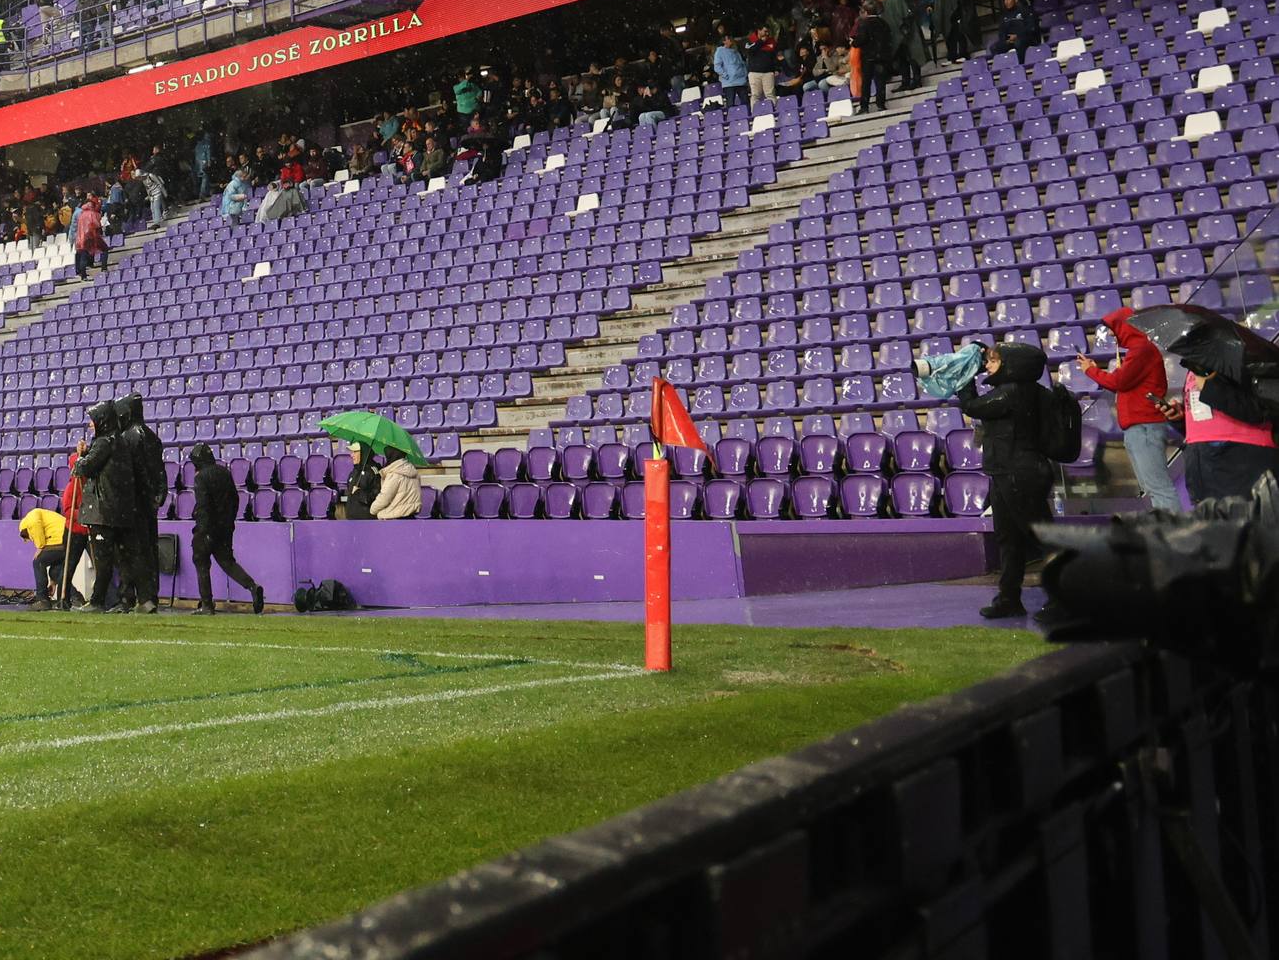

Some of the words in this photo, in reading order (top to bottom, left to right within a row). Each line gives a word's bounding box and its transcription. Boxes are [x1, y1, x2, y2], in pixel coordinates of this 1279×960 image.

[154, 62, 240, 95] ESTADIO
[247, 43, 301, 71] JOSÉ
[309, 13, 423, 55] ZORRILLA
